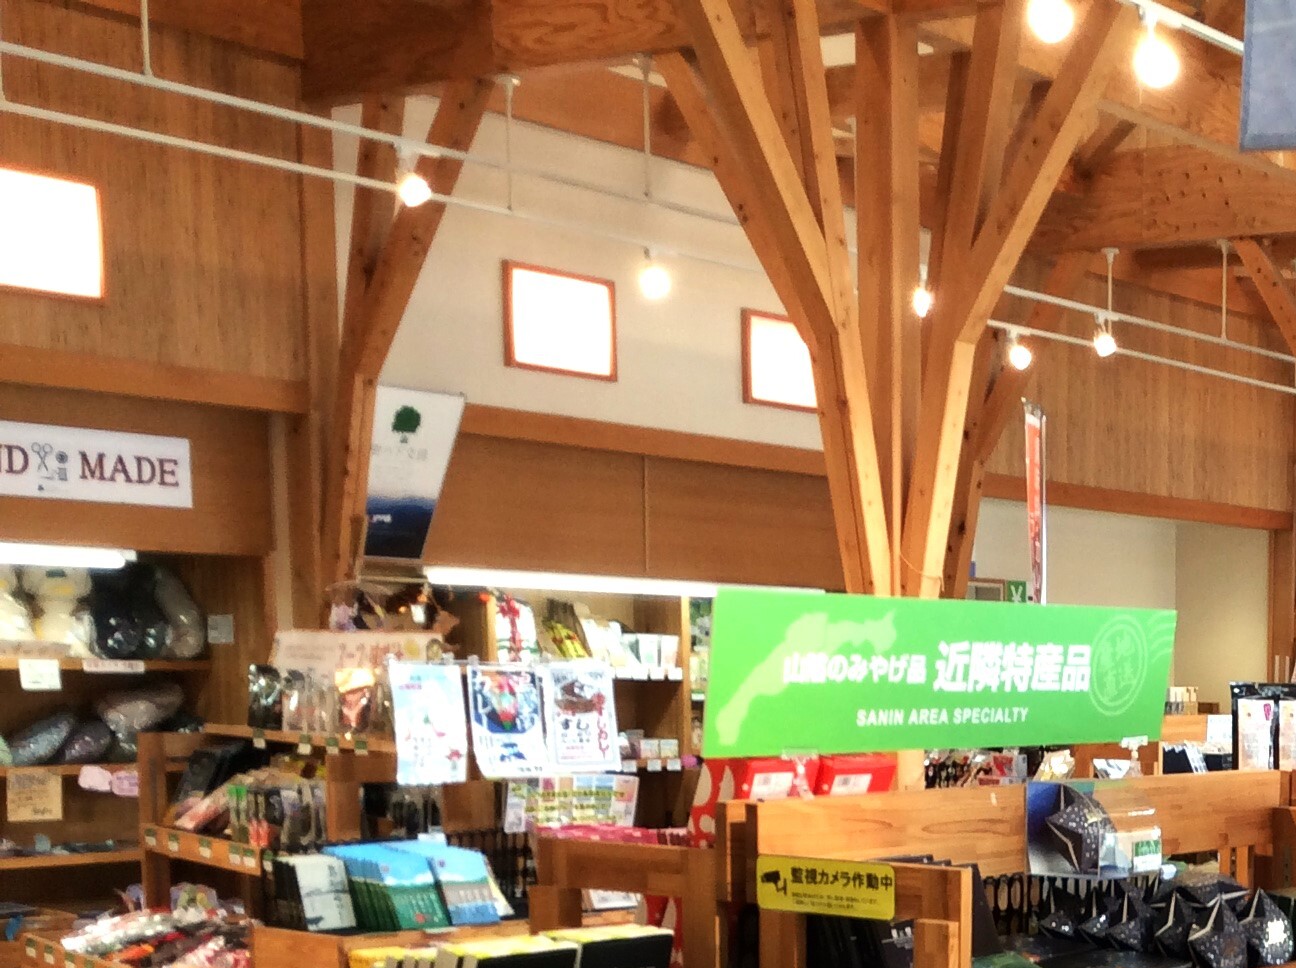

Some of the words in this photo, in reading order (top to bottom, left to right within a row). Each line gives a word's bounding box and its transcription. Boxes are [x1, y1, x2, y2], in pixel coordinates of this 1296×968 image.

[79, 450, 180, 488] MADE
[933, 641, 1091, 693] 近隣特産品
[857, 708, 905, 728] SANIN
[908, 708, 950, 726] AREA
[952, 706, 1029, 725] SPECIALTY
[791, 866, 893, 891] 監視カメラ作動中
